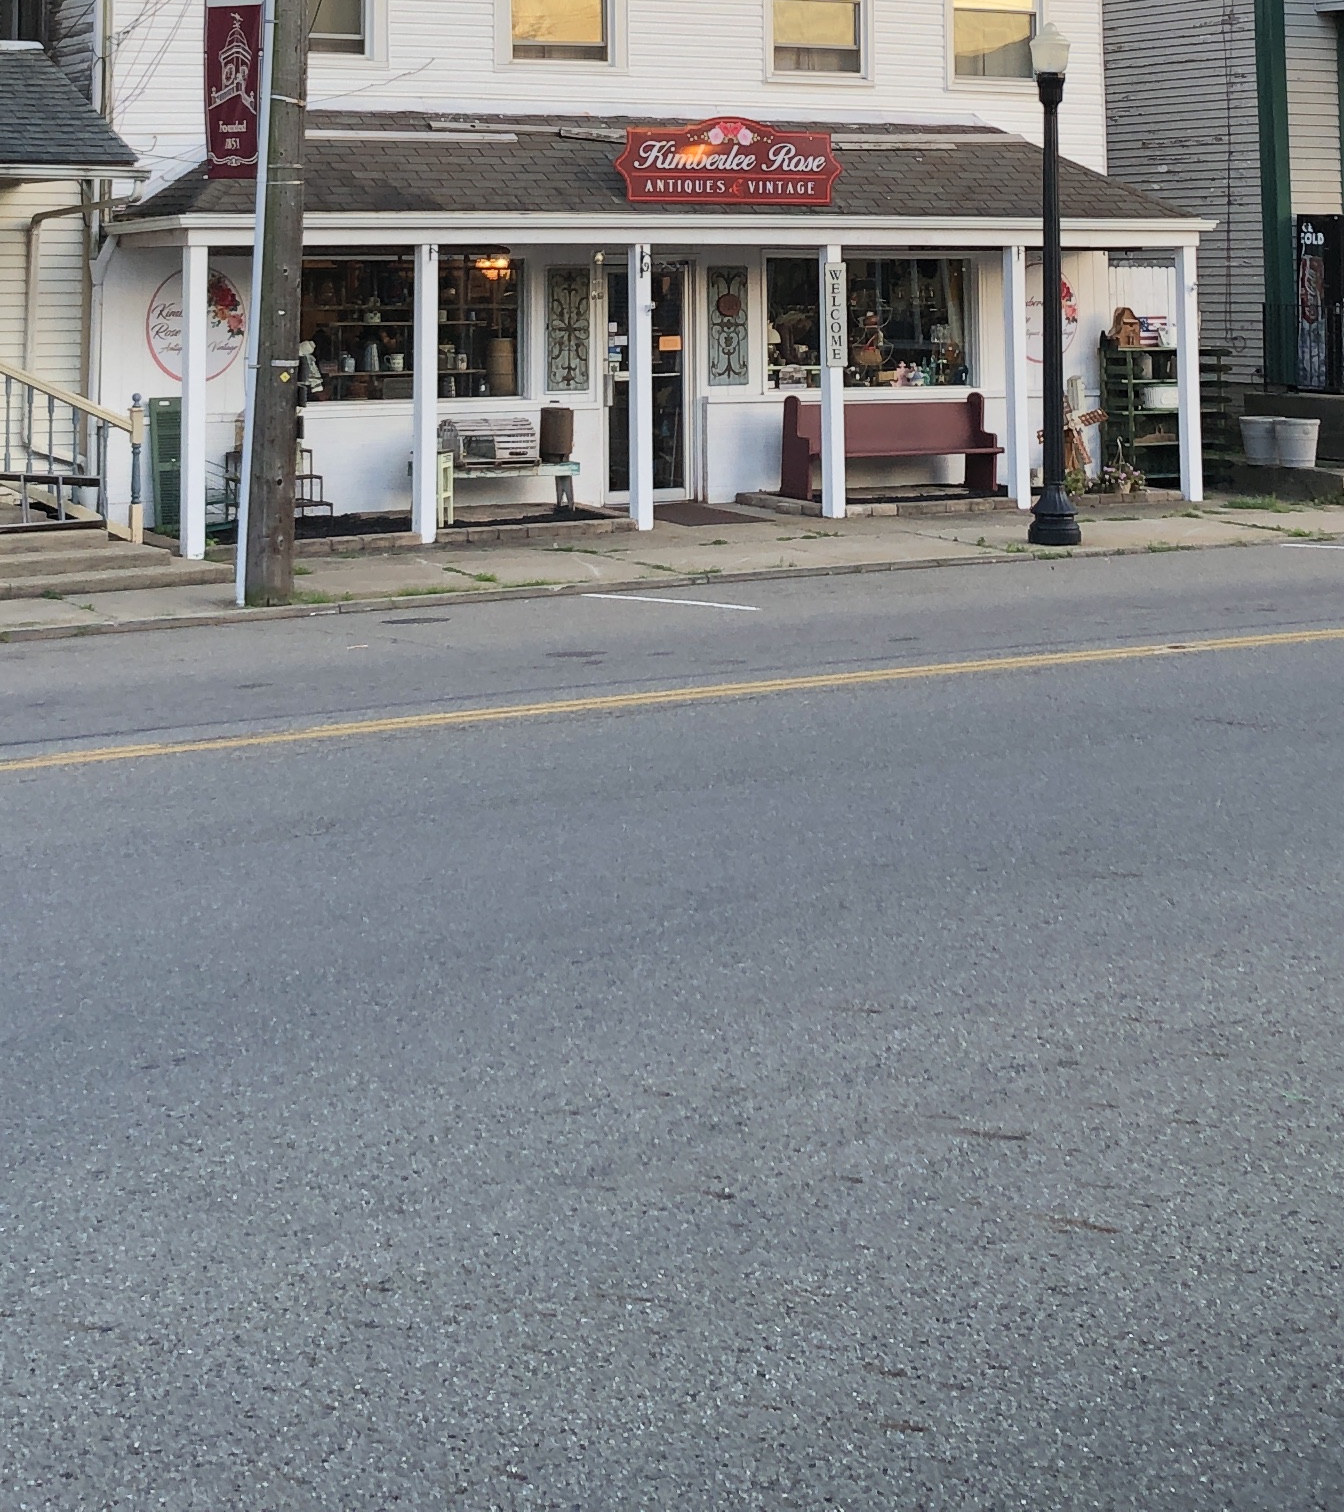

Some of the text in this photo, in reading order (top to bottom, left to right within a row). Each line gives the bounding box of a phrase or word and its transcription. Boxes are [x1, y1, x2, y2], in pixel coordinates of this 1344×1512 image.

[219, 120, 247, 133] Founded
[225, 138, 240, 150] 1851
[634, 140, 827, 172] Kimberlee Rose
[645, 179, 726, 194] ANTIQUES
[748, 180, 816, 195] VINTAGE
[829, 270, 843, 360] WELCOME
[151, 323, 181, 340] Rose
